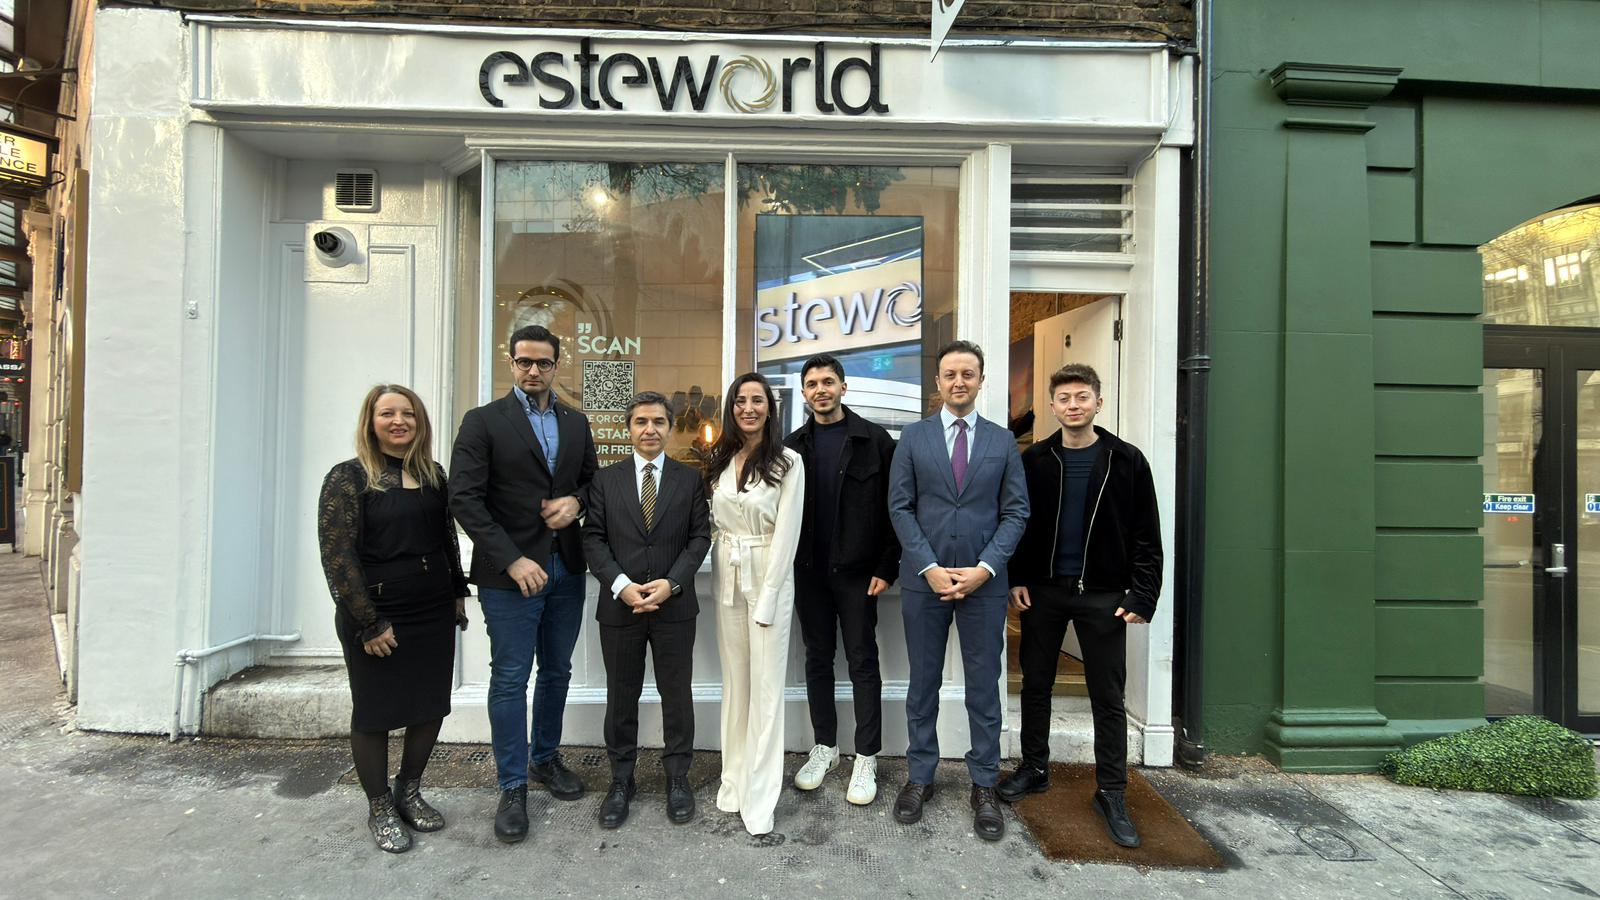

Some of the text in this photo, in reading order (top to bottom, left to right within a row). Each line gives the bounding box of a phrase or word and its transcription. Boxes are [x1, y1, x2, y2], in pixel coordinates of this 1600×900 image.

[479, 36, 889, 115] esteworld
[577, 335, 641, 355] SCAN
[596, 414, 611, 424] QR
